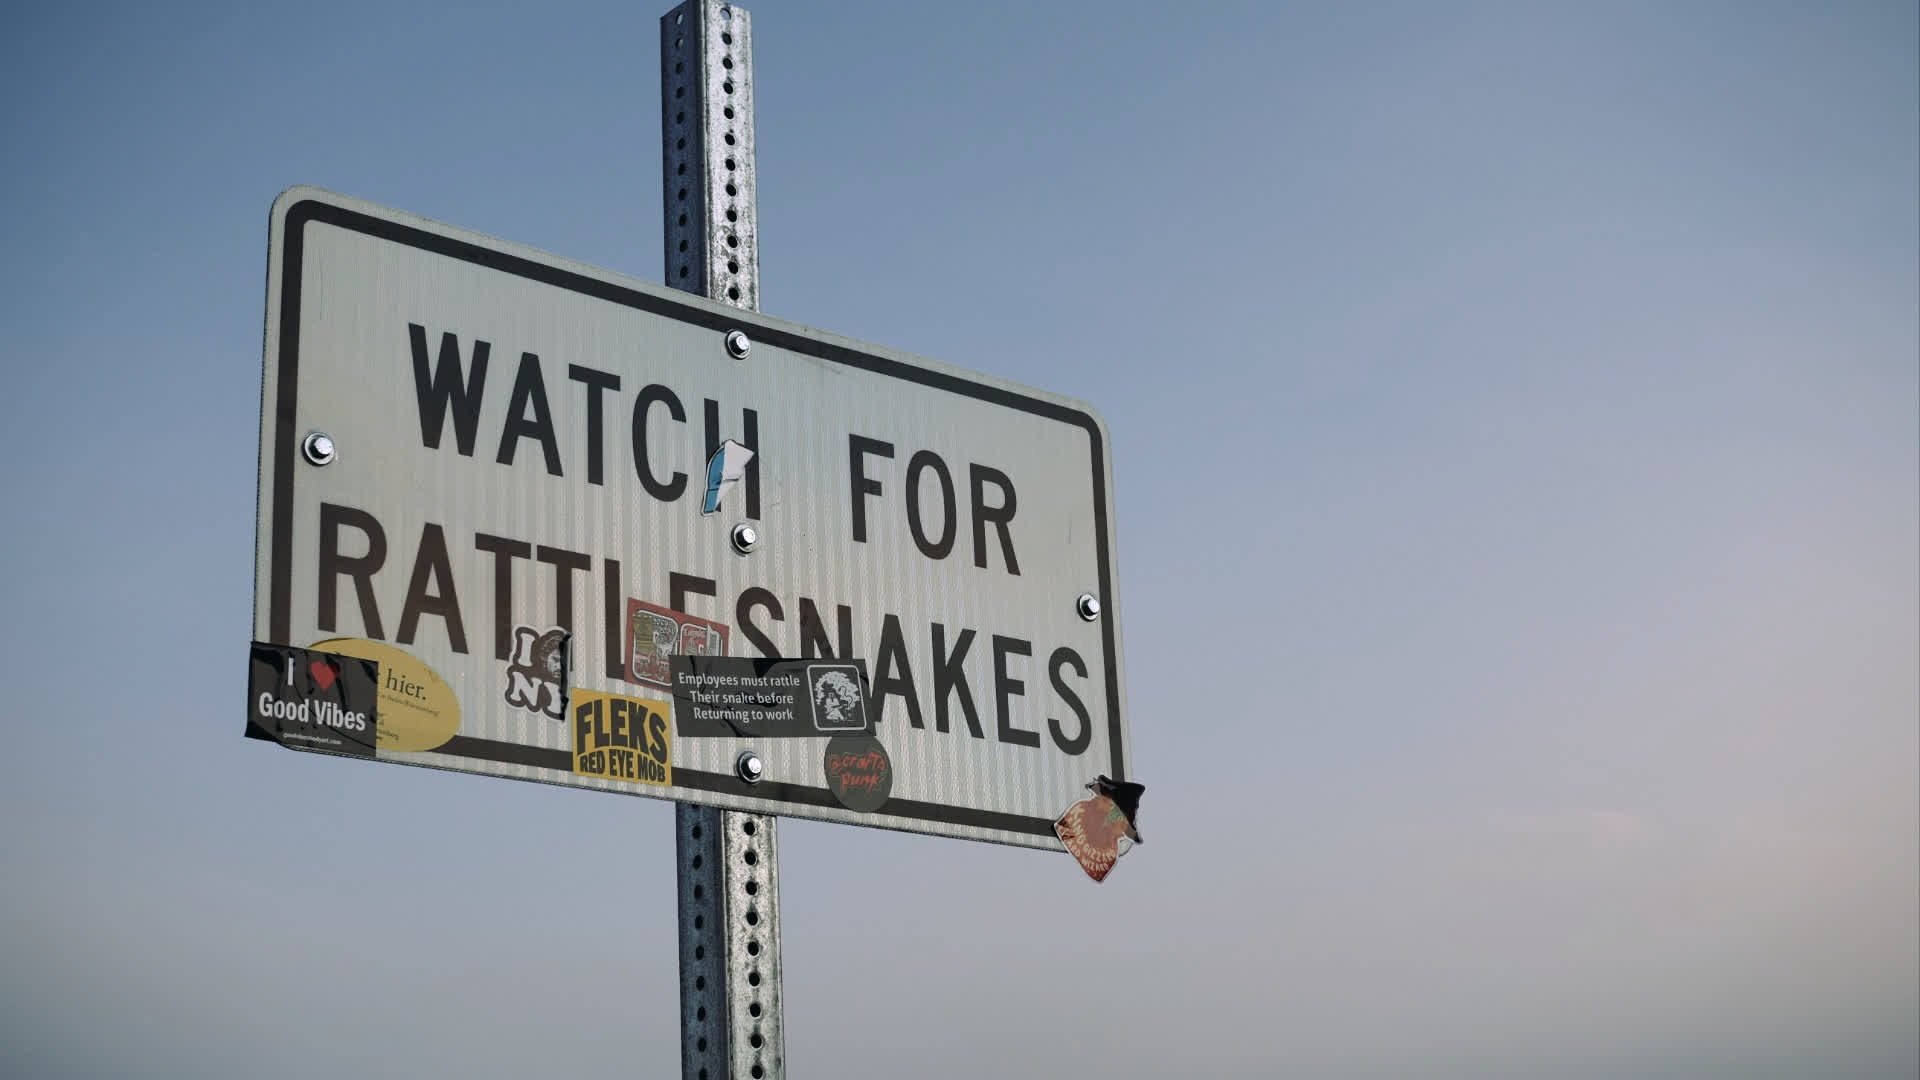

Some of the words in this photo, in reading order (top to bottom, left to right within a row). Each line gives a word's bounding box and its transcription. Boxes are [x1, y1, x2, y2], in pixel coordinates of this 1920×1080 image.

[408, 323, 760, 520] WATCH
[849, 434, 1021, 576] FOR
[287, 657, 295, 686] I
[385, 668, 427, 701] hier.
[678, 672, 738, 688] Employees
[741, 675, 768, 687] must
[770, 672, 800, 687] rattle
[259, 692, 309, 723] Good
[314, 700, 366, 731] Vibes
[690, 690, 719, 704] Their
[722, 691, 755, 704] snake
[757, 692, 794, 704] before
[576, 698, 668, 765] FLEKS
[693, 707, 749, 723] Returning
[751, 710, 763, 721] to
[766, 708, 794, 721] work
[579, 750, 606, 775] RED
[608, 749, 635, 778] EYE
[637, 755, 666, 783] MOB
